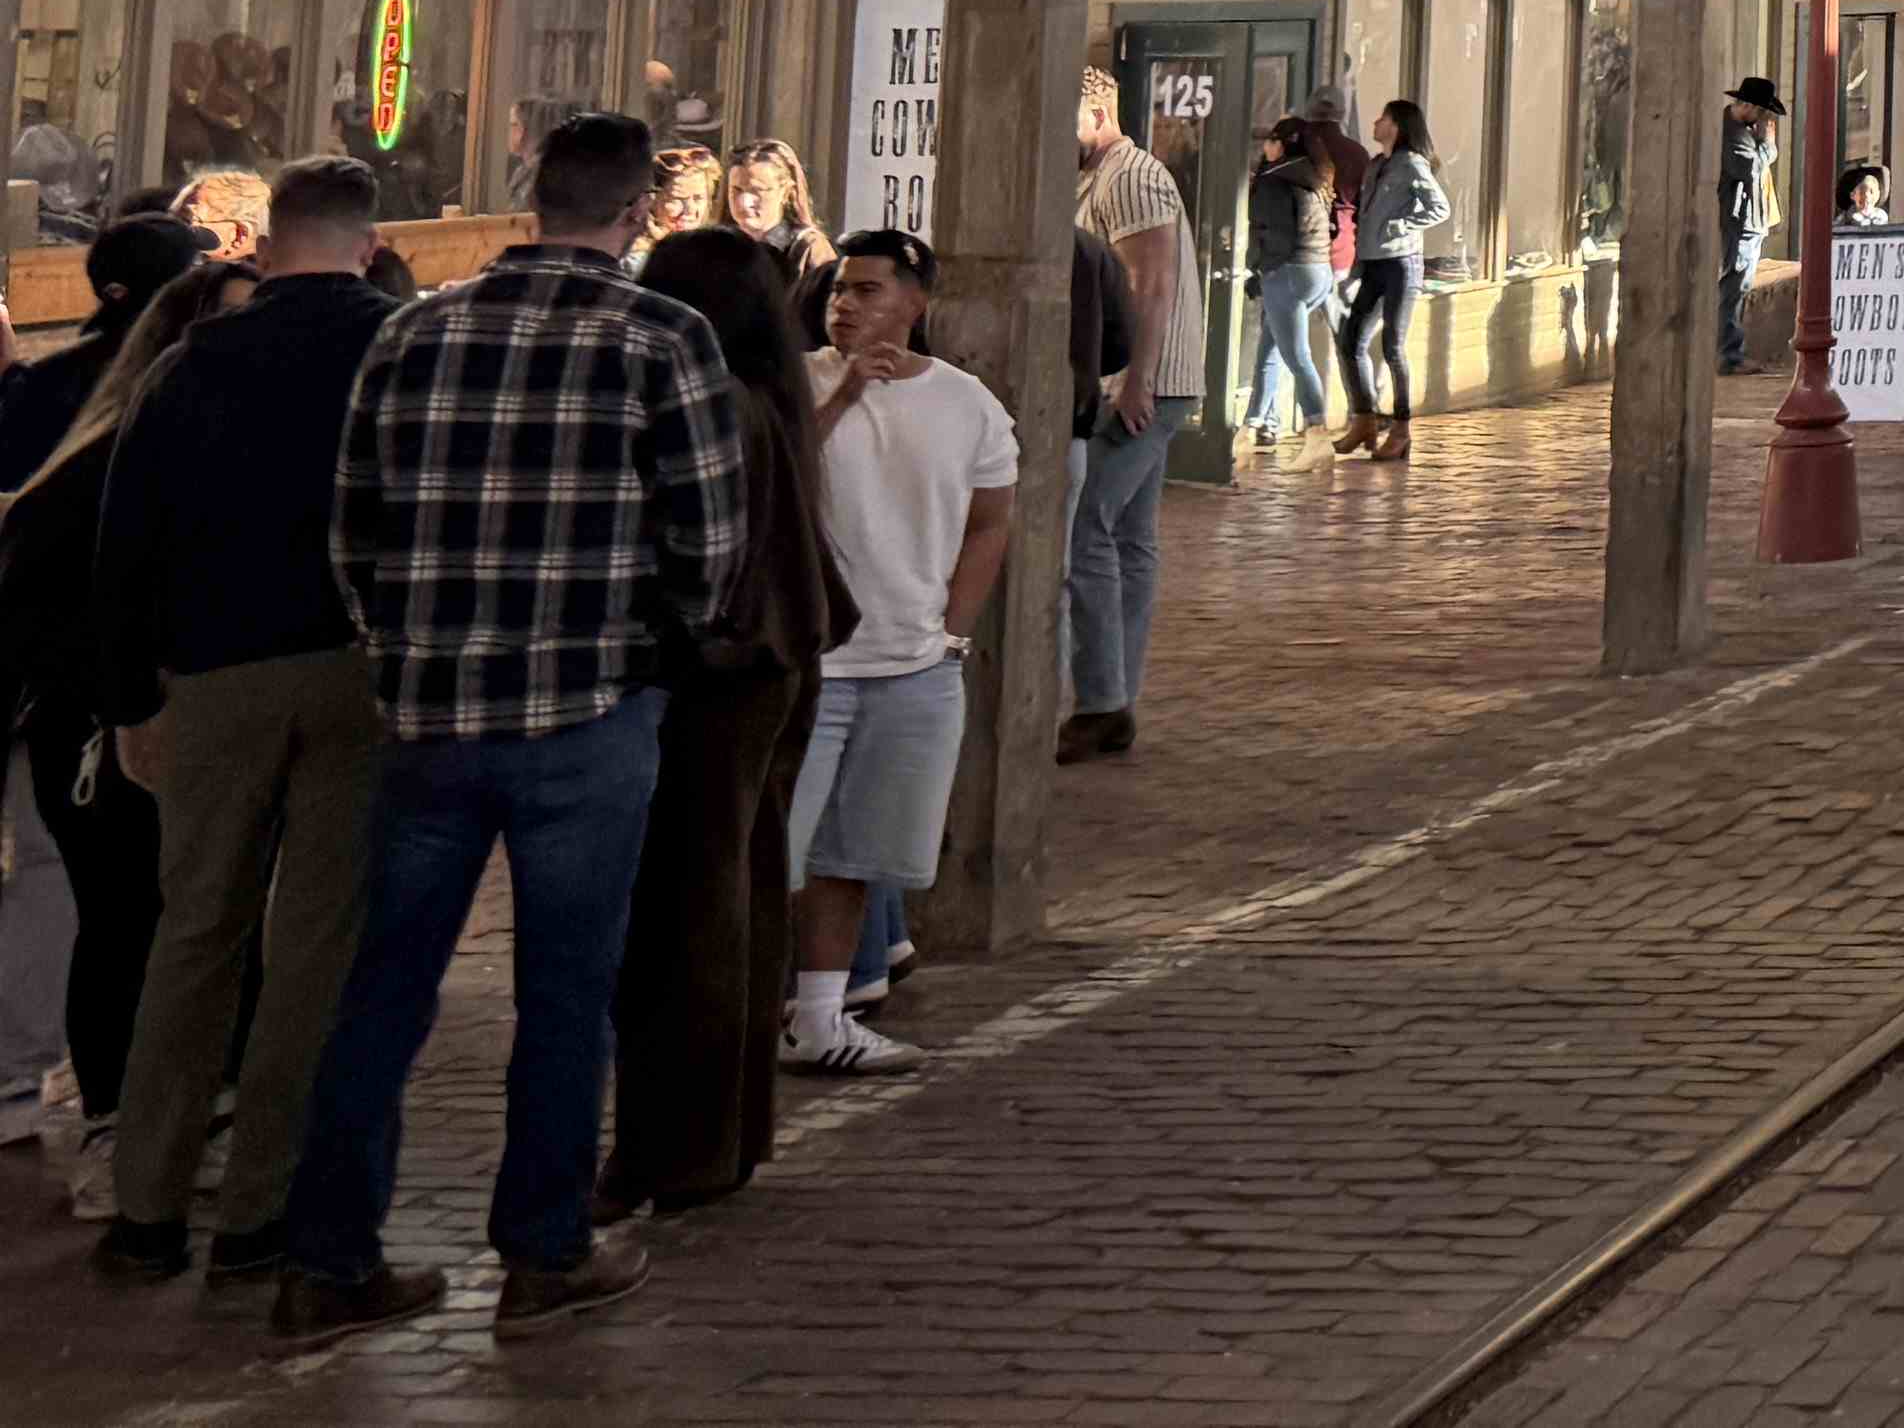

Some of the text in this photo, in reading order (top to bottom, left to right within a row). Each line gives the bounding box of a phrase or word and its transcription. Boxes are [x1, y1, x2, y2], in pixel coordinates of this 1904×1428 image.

[889, 28, 941, 85] ME
[1160, 74, 1214, 118] 125
[871, 99, 936, 157] COW
[883, 175, 925, 233] BO
